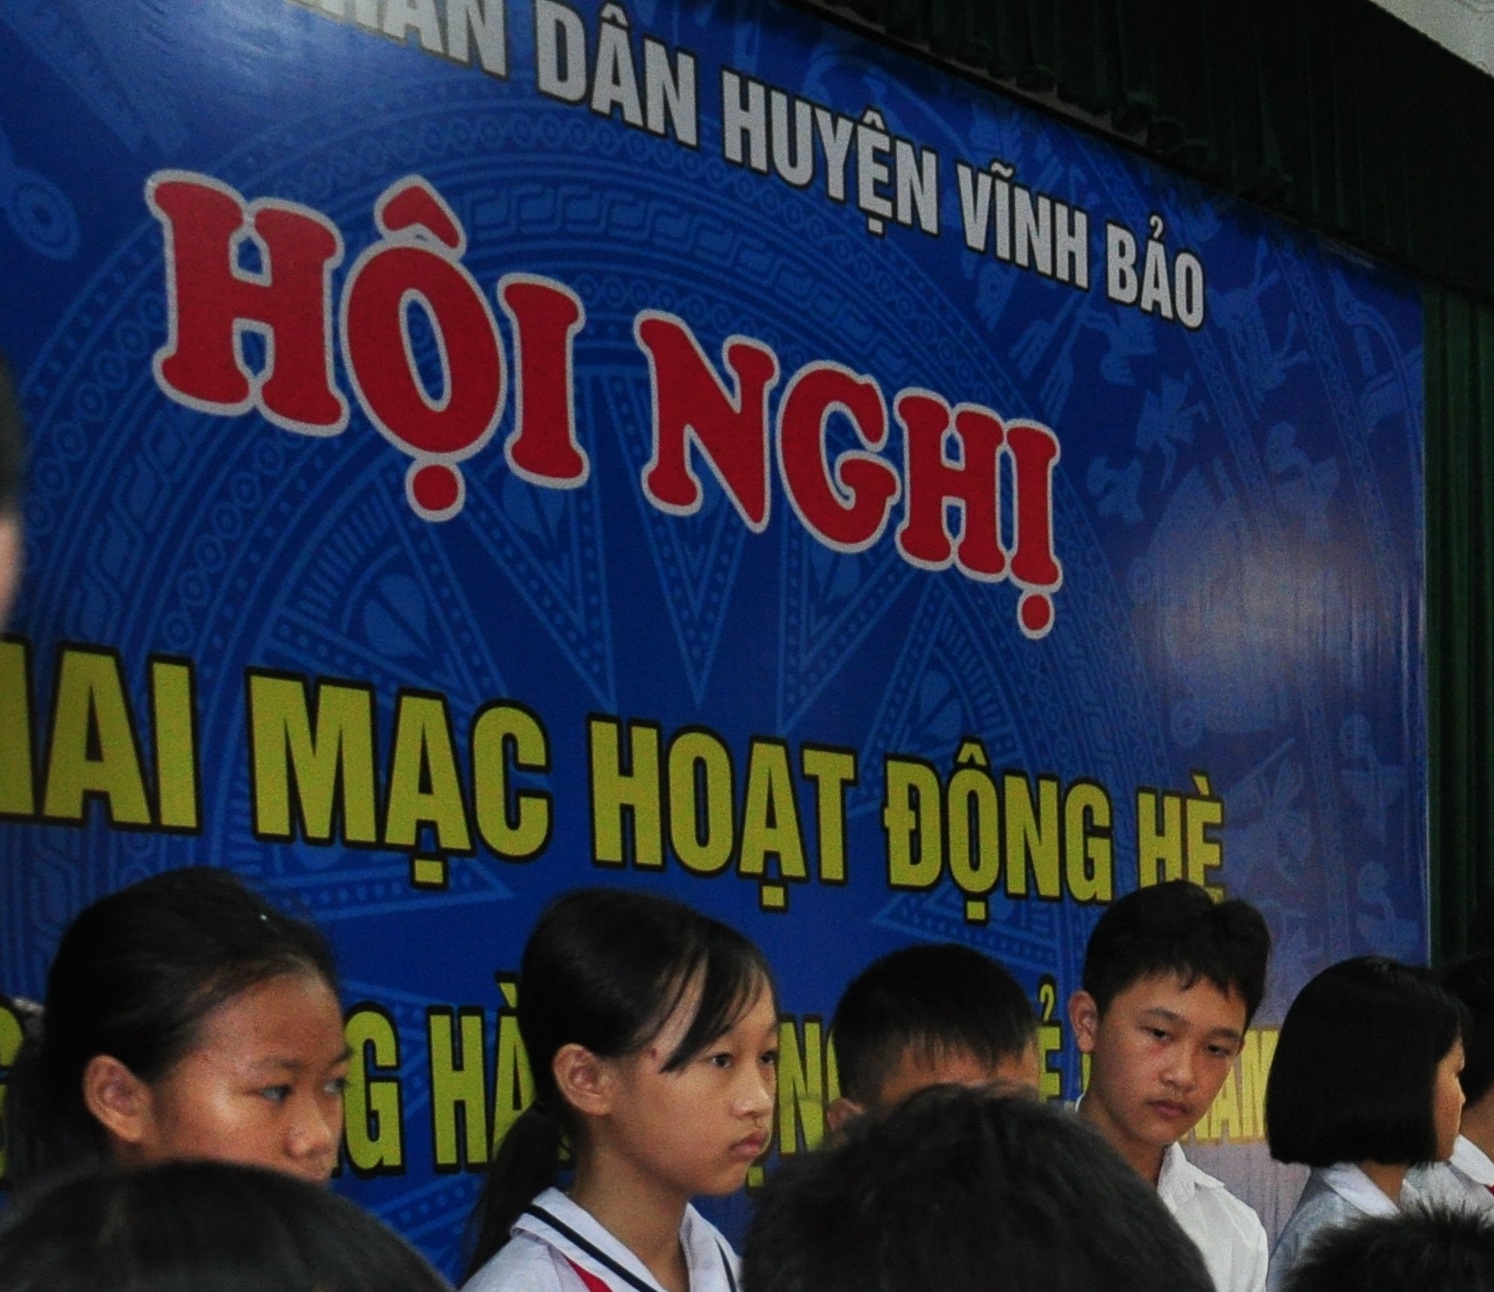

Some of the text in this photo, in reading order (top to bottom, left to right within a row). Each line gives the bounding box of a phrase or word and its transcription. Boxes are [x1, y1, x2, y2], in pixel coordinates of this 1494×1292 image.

[535, 0, 699, 149] DÂN
[720, 68, 941, 238] HUYỆN
[956, 160, 1091, 291] VĨNH
[1105, 214, 1206, 332] BẢO
[145, 168, 1062, 640] HỘI NGHỊ
[246, 666, 553, 891] MẠC
[587, 713, 858, 911] HOẠT
[881, 736, 1114, 924] ĐỘNG
[1136, 769, 1226, 905] HÈ
